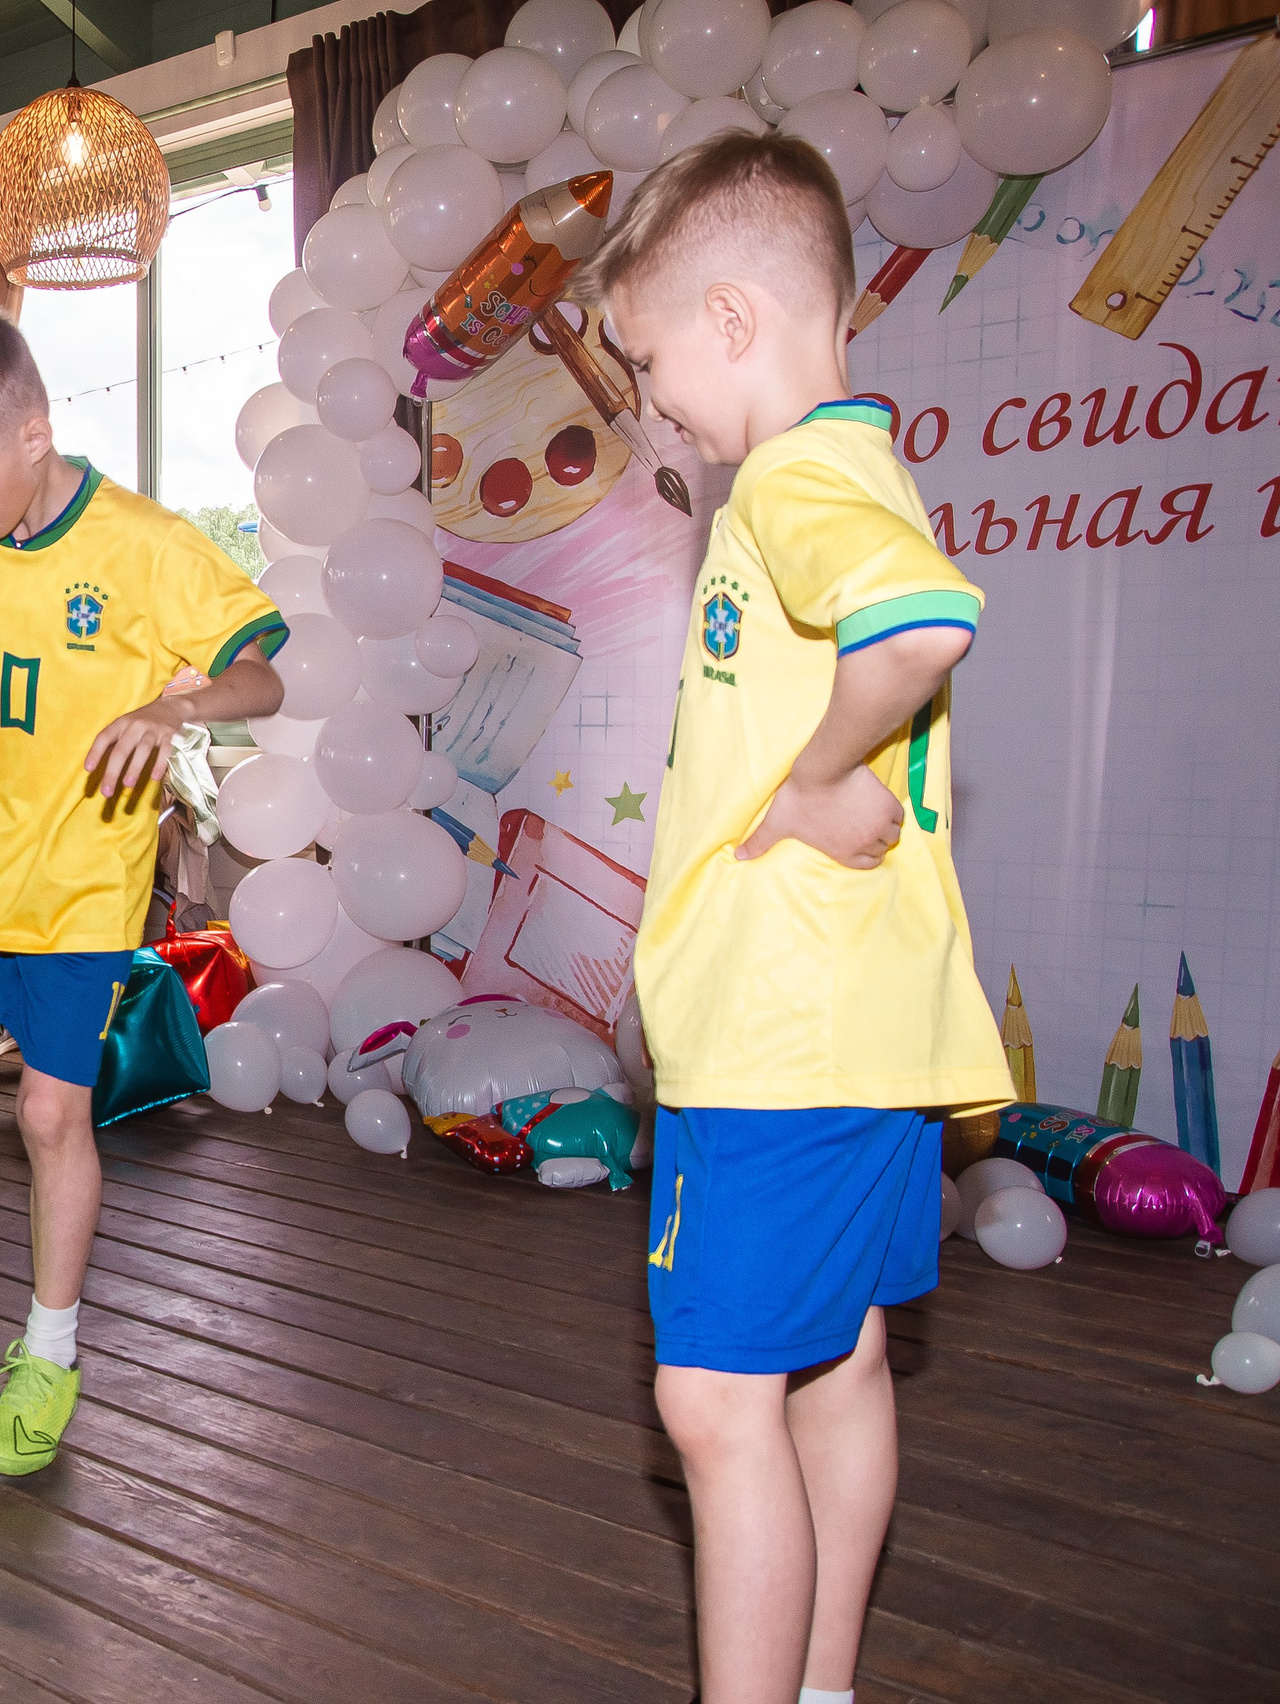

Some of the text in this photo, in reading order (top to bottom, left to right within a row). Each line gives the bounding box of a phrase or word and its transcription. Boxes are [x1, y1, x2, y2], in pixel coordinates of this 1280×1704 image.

[460, 312, 509, 347] IS CO
[981, 342, 1280, 457] свида
[926, 482, 1215, 557] льная
